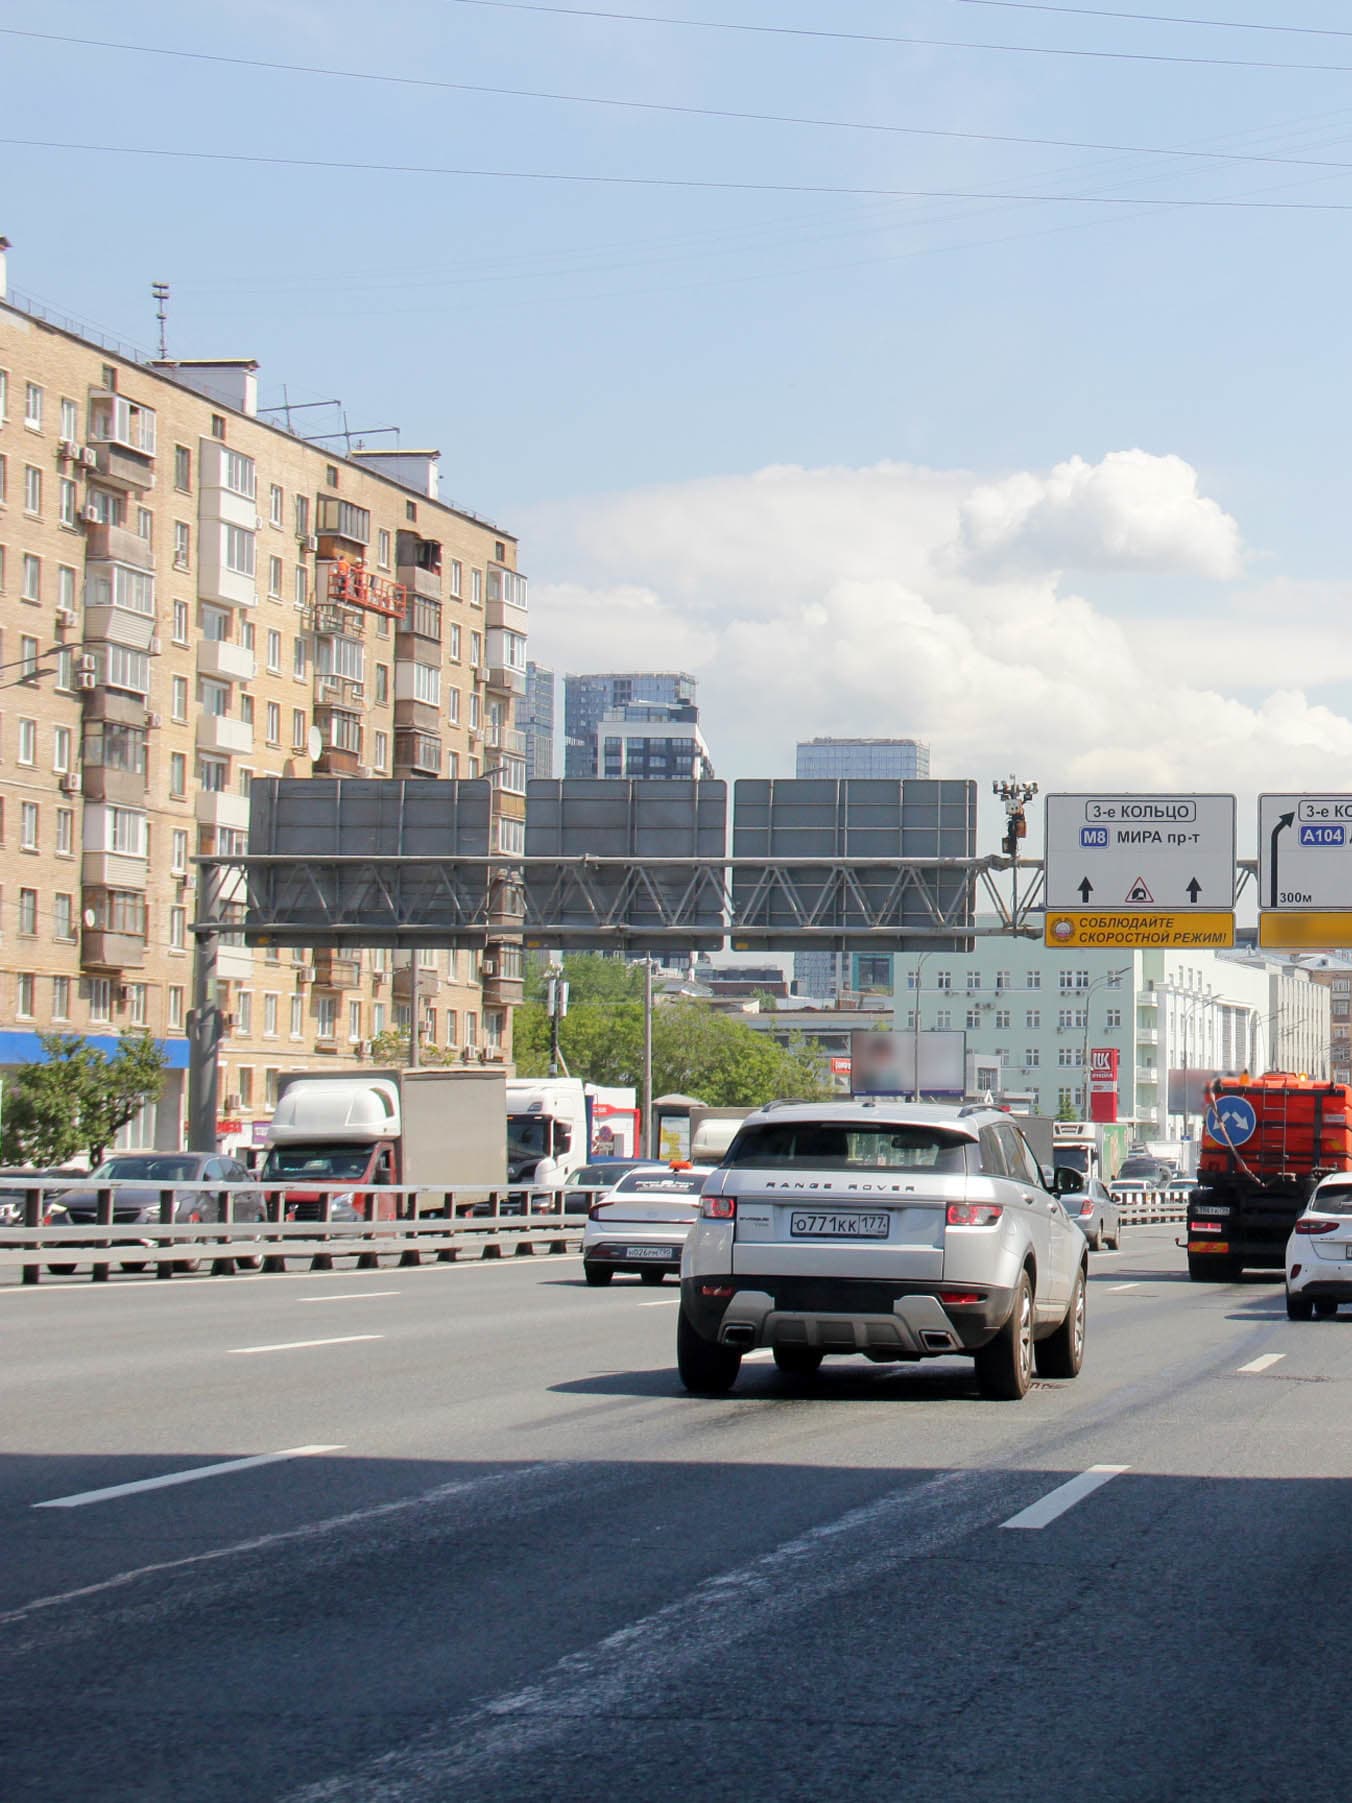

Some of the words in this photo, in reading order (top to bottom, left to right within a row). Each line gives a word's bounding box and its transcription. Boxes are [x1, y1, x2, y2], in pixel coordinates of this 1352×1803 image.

[1093, 805, 1115, 818] 3-е
[1121, 805, 1190, 820] КОЛЬЦО
[1306, 805, 1329, 818] 3-е
[1083, 829, 1107, 844] М8
[1117, 831, 1162, 844] МИРА
[1168, 833, 1200, 847] пр-т
[1303, 829, 1343, 844] А104
[1279, 892, 1312, 903] 300м
[1079, 916, 1174, 930] СОБЛЮДАЙТЕ
[1079, 930, 1169, 944] СКОРОСТНОЙ
[1173, 932, 1227, 944] РЕЖИМ!
[848, 1184, 915, 1192] ROVER
